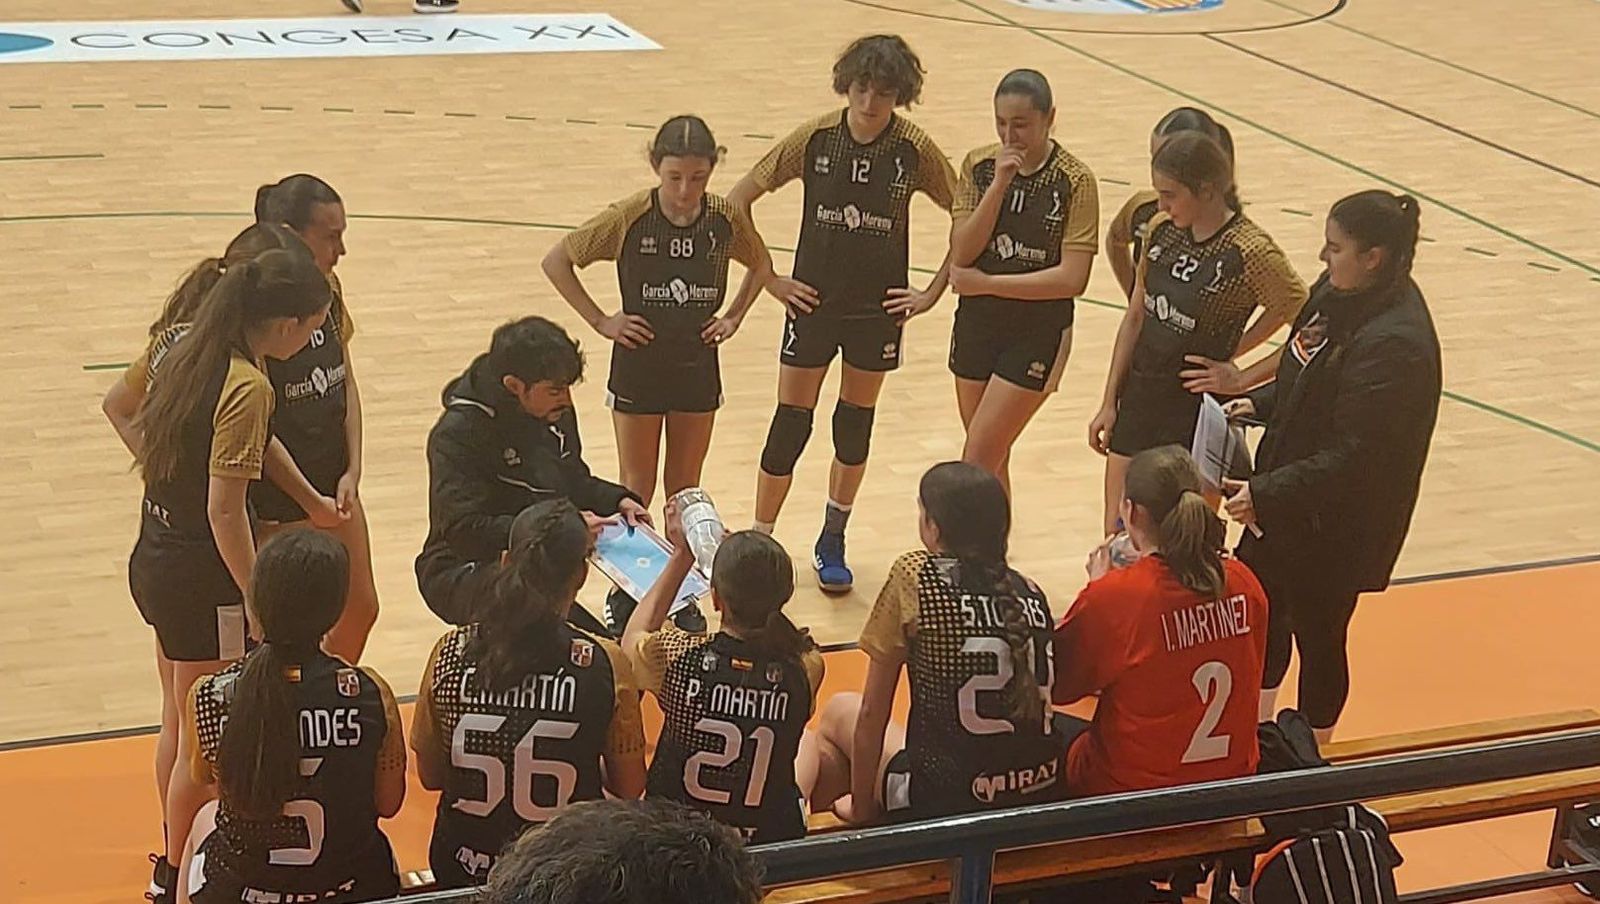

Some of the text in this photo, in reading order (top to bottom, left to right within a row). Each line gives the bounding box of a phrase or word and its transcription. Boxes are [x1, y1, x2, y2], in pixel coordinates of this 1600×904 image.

[70, 25, 630, 48] CONGESA XXI
[851, 159, 870, 182] 12
[1010, 190, 1024, 213] 11
[670, 238, 693, 257] 88
[1171, 254, 1198, 281] 22
[642, 283, 671, 298] García
[285, 377, 314, 398] García
[710, 684, 789, 720] MARTÍN
[1180, 661, 1232, 763] 2
[450, 713, 581, 822] 56
[683, 718, 775, 807] 21
